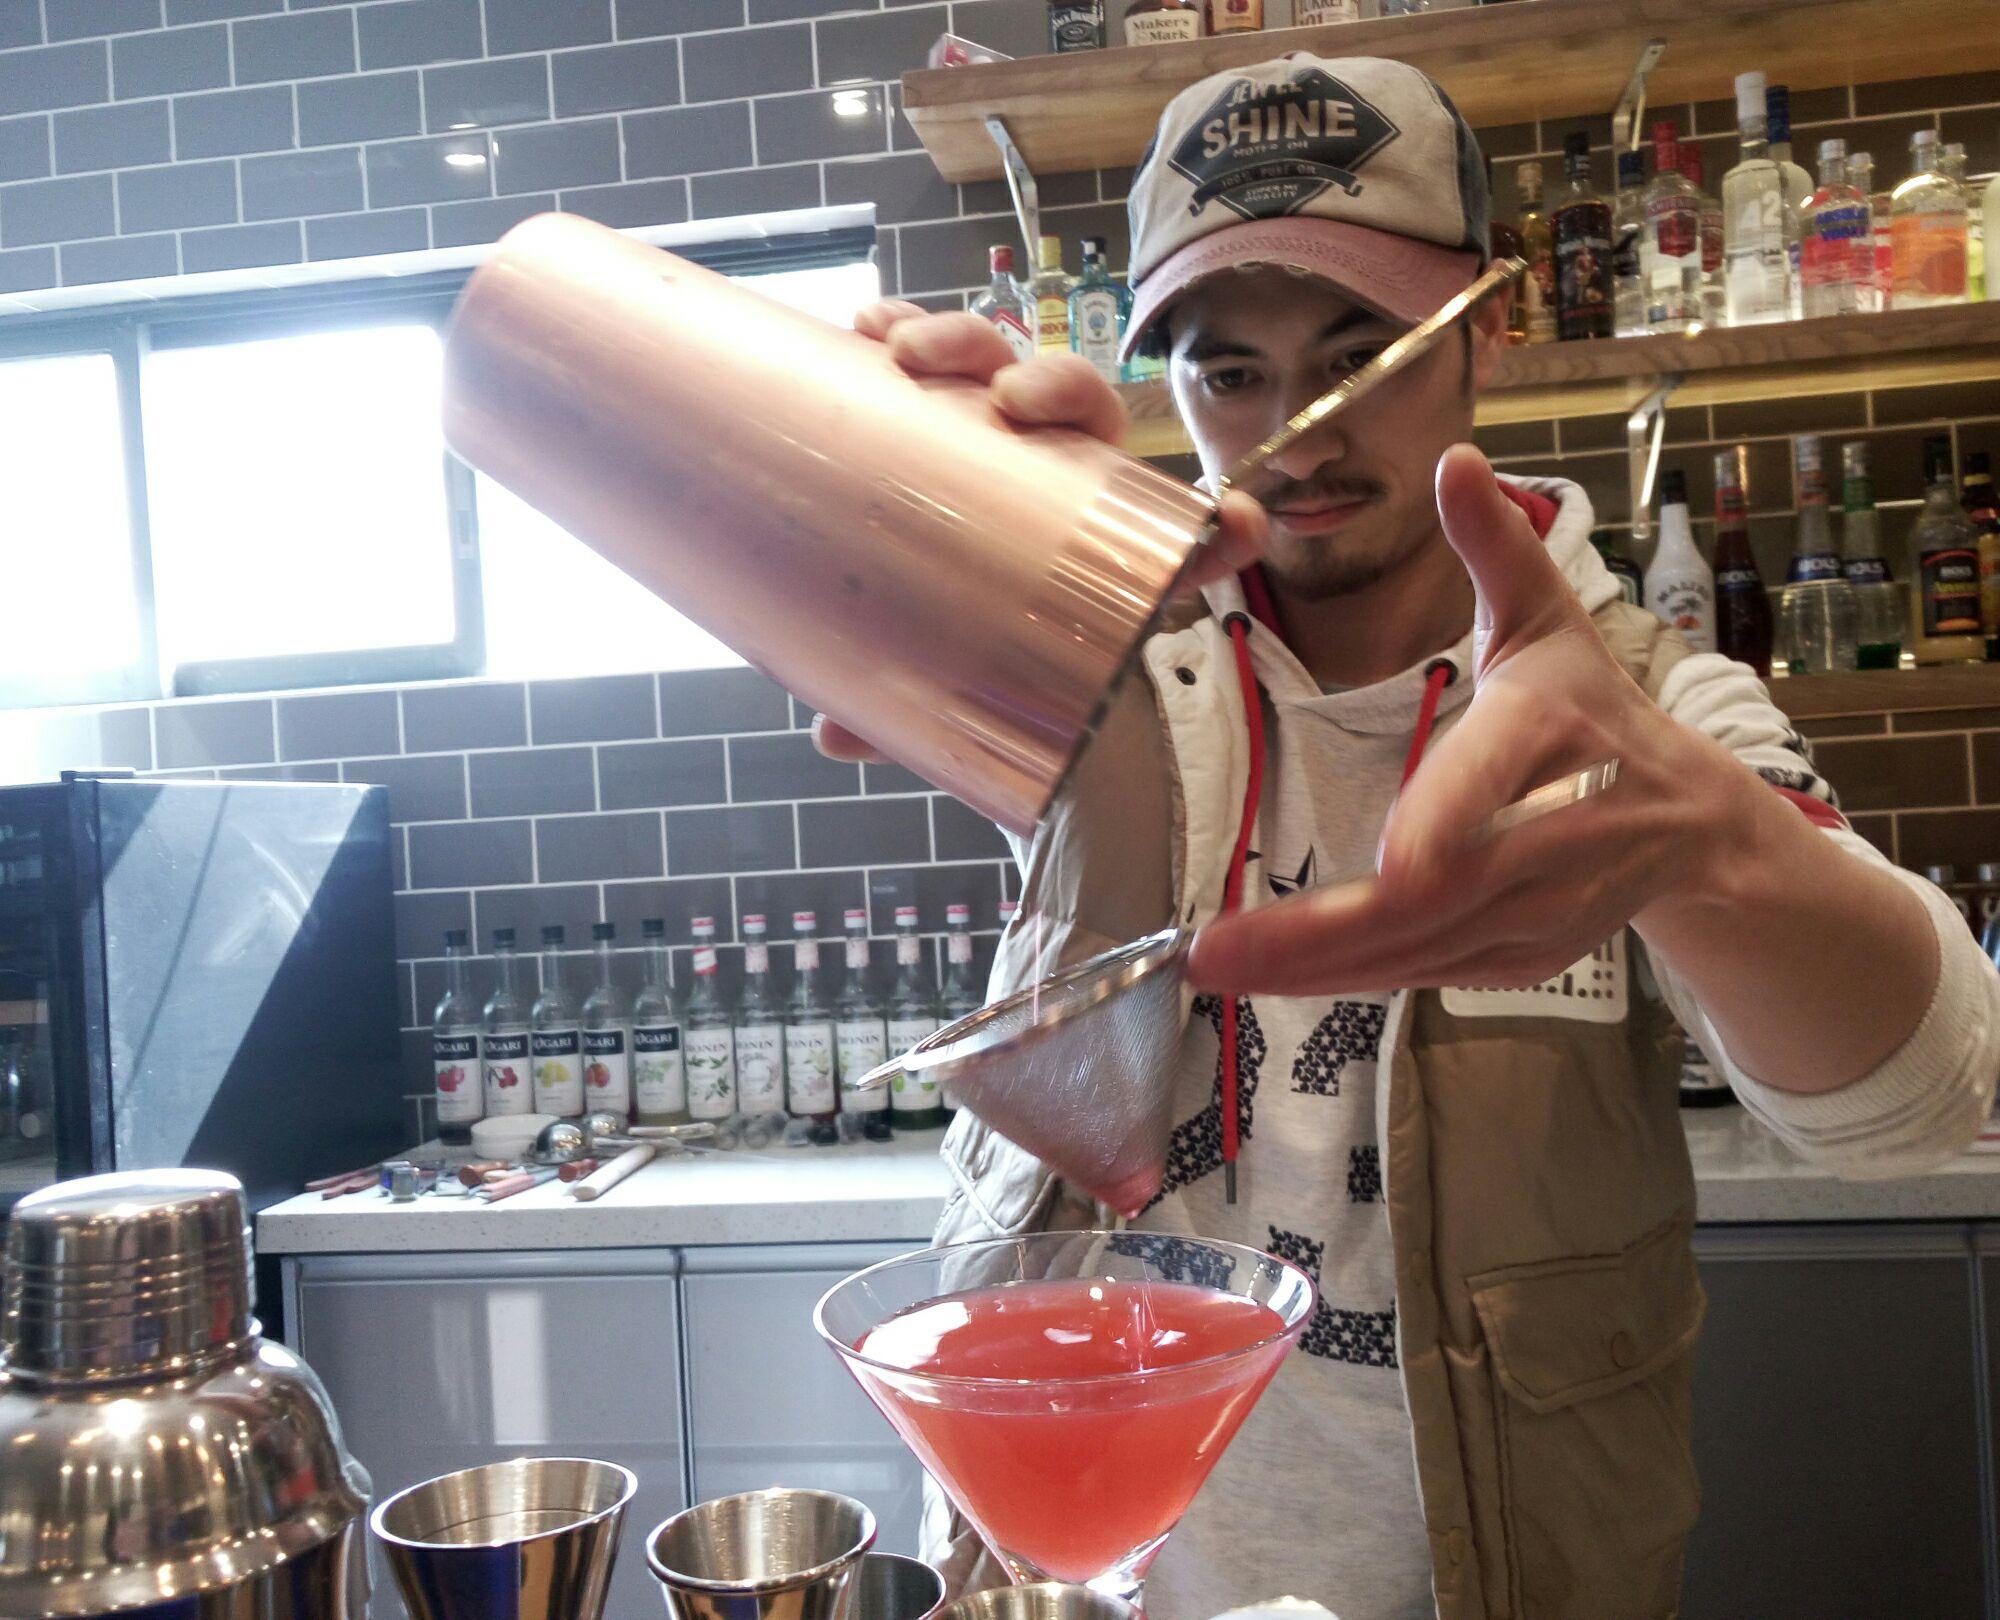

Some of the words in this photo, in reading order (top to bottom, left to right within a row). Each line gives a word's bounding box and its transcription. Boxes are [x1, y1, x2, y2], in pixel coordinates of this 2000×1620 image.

[1133, 18, 1190, 30] Maker's
[1150, 30, 1189, 41] Mark
[1202, 99, 1358, 160] SHINE
